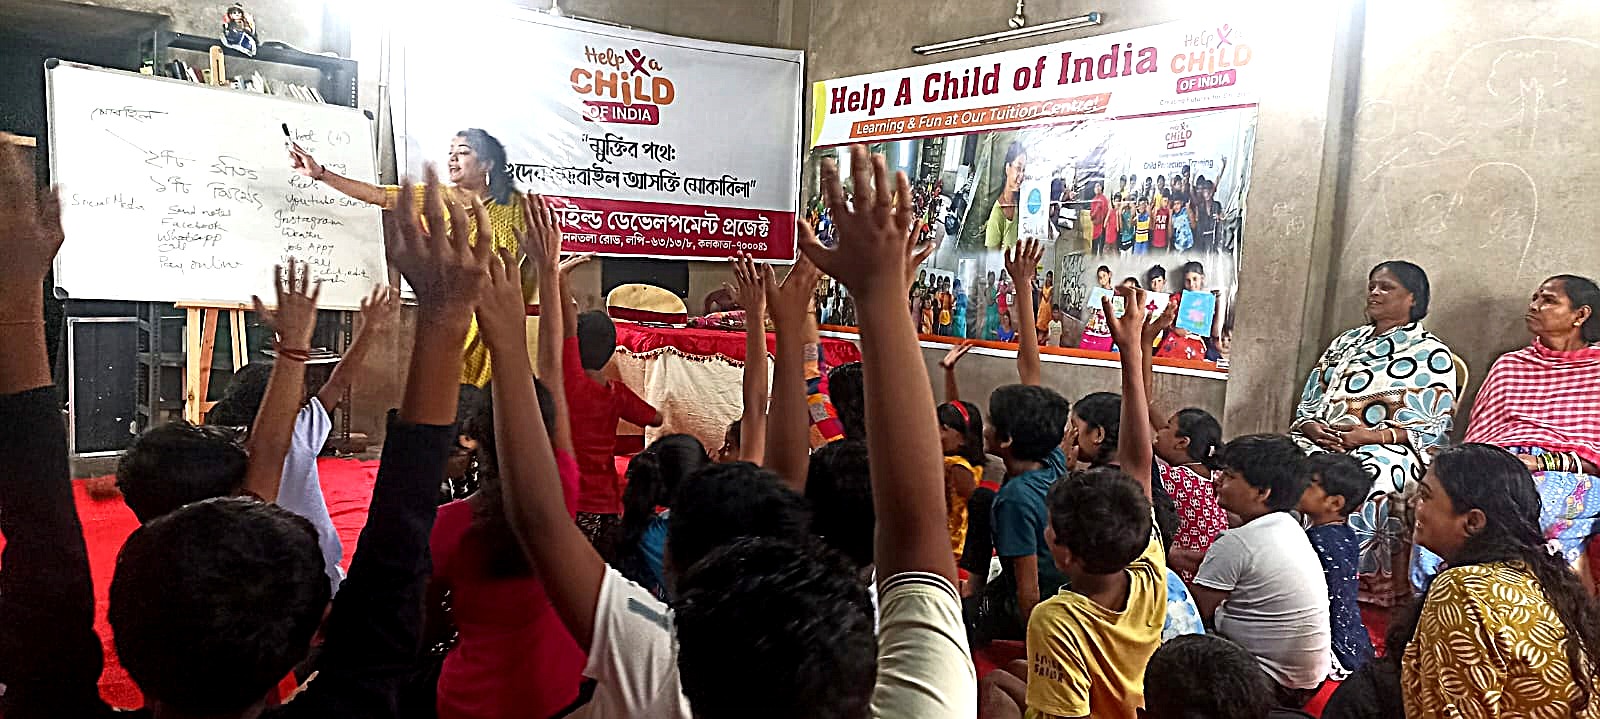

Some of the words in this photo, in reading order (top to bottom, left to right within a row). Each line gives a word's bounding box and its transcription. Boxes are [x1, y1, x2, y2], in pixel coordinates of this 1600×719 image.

[584, 45, 625, 71] Help
[648, 58, 663, 71] a
[829, 83, 886, 116] Help
[894, 77, 912, 106] A
[923, 63, 1002, 102] Child
[1012, 56, 1048, 91] of
[1057, 43, 1158, 85] India
[1180, 79, 1197, 91] OF
[1198, 73, 1231, 88] INDIA
[588, 105, 608, 119] OF
[612, 106, 652, 121] INDIA
[856, 118, 905, 135] Learning
[907, 117, 917, 129] &
[918, 114, 942, 128] Fun
[944, 113, 959, 126] at
[961, 110, 985, 124] Our
[989, 104, 1038, 121] Tuition
[622, 168, 681, 192] আসক্তি
[607, 209, 721, 235] ডেভেলপমেন্ট
[722, 213, 771, 238] প্রজেক্ট
